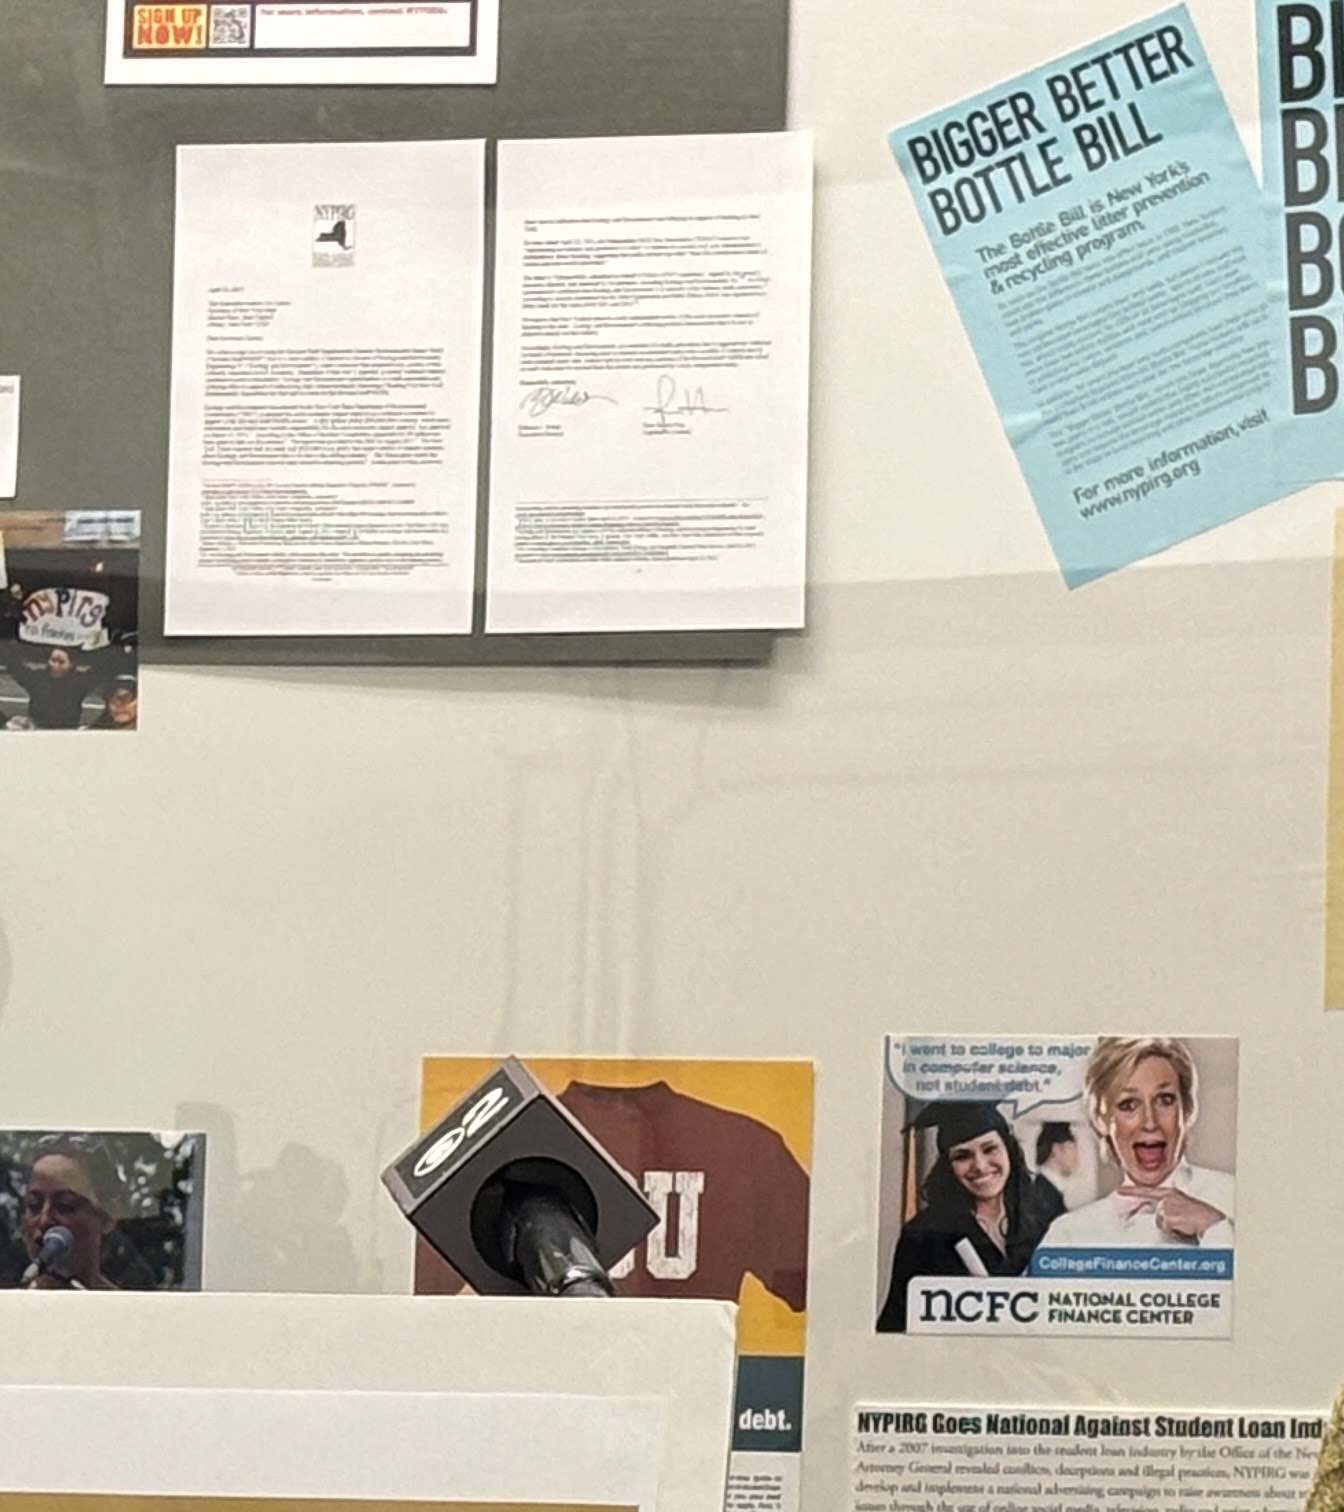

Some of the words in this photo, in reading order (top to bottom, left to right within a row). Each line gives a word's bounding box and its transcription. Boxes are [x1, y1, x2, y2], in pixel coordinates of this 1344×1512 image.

[137, 8, 178, 26] SIGN
[182, 8, 202, 26] UP
[137, 26, 202, 45] NOW!
[907, 90, 1047, 185] BIGGER
[1046, 25, 1195, 126] BETTER
[928, 145, 1072, 236] BOTTLE
[1077, 102, 1163, 172] BILL
[976, 244, 1005, 263] The
[1059, 205, 1086, 226] Bill
[1090, 199, 1104, 213] is
[1106, 182, 1142, 206] New
[1144, 161, 1190, 189] York's
[983, 253, 1022, 279] most
[1026, 226, 1089, 260] effective
[1134, 171, 1209, 217] prevention
[990, 280, 1004, 294] &
[1006, 252, 1072, 289] recycling
[1076, 220, 1146, 261] program.
[1073, 484, 1099, 504] For
[1104, 465, 1144, 491] more
[1080, 459, 1201, 519] www.nypirg.org
[951, 1044, 965, 1055] to
[970, 1043, 1024, 1059] college
[1028, 1044, 1043, 1055] to
[1048, 1044, 1090, 1058] major
[1039, 1255, 1226, 1274] CollegeFinanceCenter.org
[1048, 1292, 1136, 1309] NATIONAL
[1140, 1293, 1221, 1309] COLLEGE
[1047, 1309, 1124, 1325] FINANCE
[1126, 1309, 1194, 1325] CENTER
[738, 1408, 792, 1431] debt.
[858, 1412, 927, 1433] NYPIRG
[932, 1413, 982, 1434] Goes
[986, 1414, 1070, 1435] National
[1073, 1415, 1150, 1439] Against
[1155, 1415, 1234, 1439] Student
[1239, 1417, 1285, 1439] Loan
